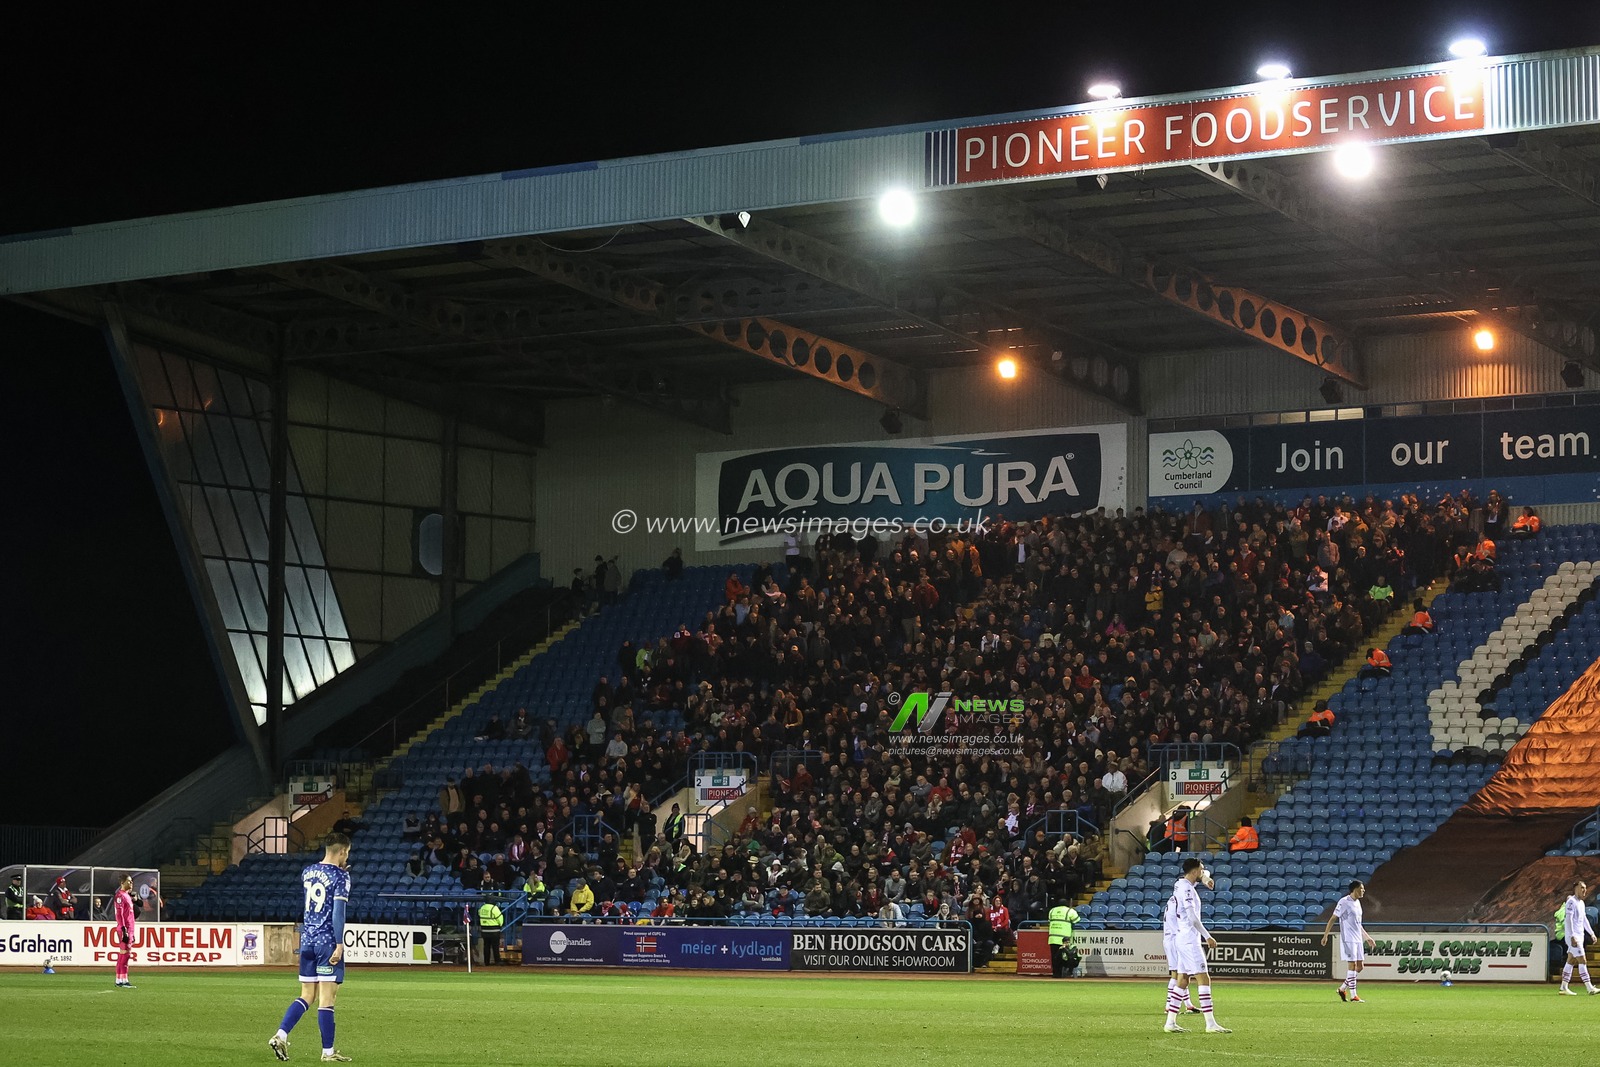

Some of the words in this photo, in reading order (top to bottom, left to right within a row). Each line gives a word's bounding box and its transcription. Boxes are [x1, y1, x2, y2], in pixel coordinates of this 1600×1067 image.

[964, 119, 1145, 173] PIONEER
[1165, 85, 1474, 151] FOODSERVICE
[1275, 439, 1343, 474] Join
[1391, 439, 1449, 466] our
[1500, 430, 1591, 461] team
[1164, 470, 1212, 482] Cumberland
[736, 462, 902, 514] AQUA
[1174, 479, 1203, 490] Council
[1171, 772, 1177, 780] 3
[1220, 771, 1227, 780] 4
[303, 881, 326, 913] 19
[9, 934, 73, 953] Graham
[792, 934, 825, 951] BEN
[830, 934, 917, 951] HODGSON
[921, 934, 967, 952] CARS
[1072, 936, 1087, 945] NEW
[1089, 936, 1109, 945] NAME
[1110, 936, 1124, 945] FOR
[1278, 936, 1312, 945] Kitchen
[364, 950, 407, 958] SPONSOR
[681, 940, 717, 955] meier
[732, 940, 783, 959] kydland
[1093, 948, 1102, 956] IN
[1104, 948, 1135, 956] CUMBRIA
[1278, 947, 1319, 957] Bedroom
[1438, 940, 1533, 957] CONCRETE
[147, 951, 222, 963] SCRAP
[803, 954, 827, 966] VISIT
[828, 955, 850, 966] OUR
[852, 955, 889, 967] ONLINE
[892, 955, 955, 967] SHOWROOM
[1144, 953, 1167, 961] Canon
[1278, 960, 1327, 969] Bathrooms
[1397, 958, 1482, 974] SUPPLIES
